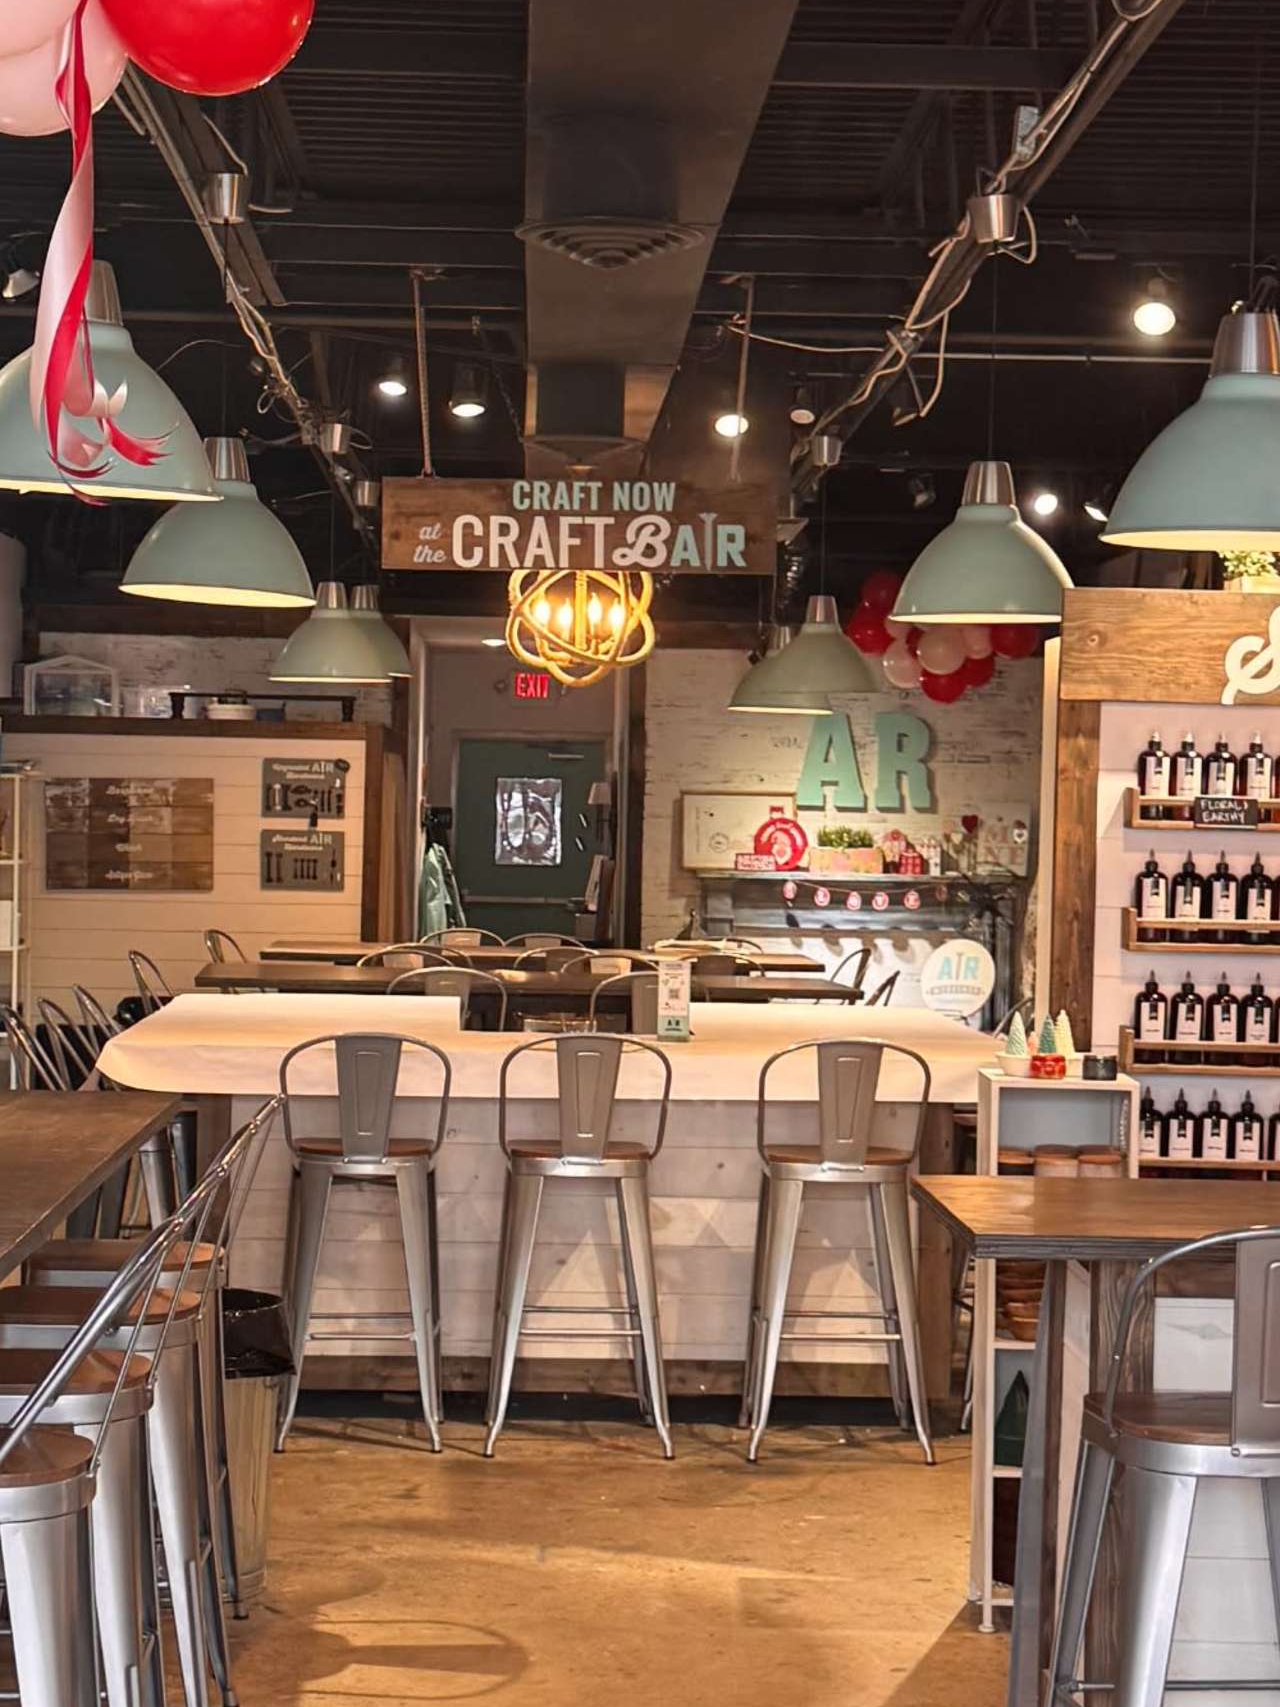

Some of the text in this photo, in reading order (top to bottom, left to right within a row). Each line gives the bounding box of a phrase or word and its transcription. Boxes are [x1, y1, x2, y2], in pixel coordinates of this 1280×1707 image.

[513, 481, 676, 511] CRAFT NOW
[419, 524, 442, 540] at
[452, 514, 614, 568] CRAFT
[413, 545, 447, 563] the
[515, 674, 551, 698] EXIT
[796, 713, 931, 809] AR
